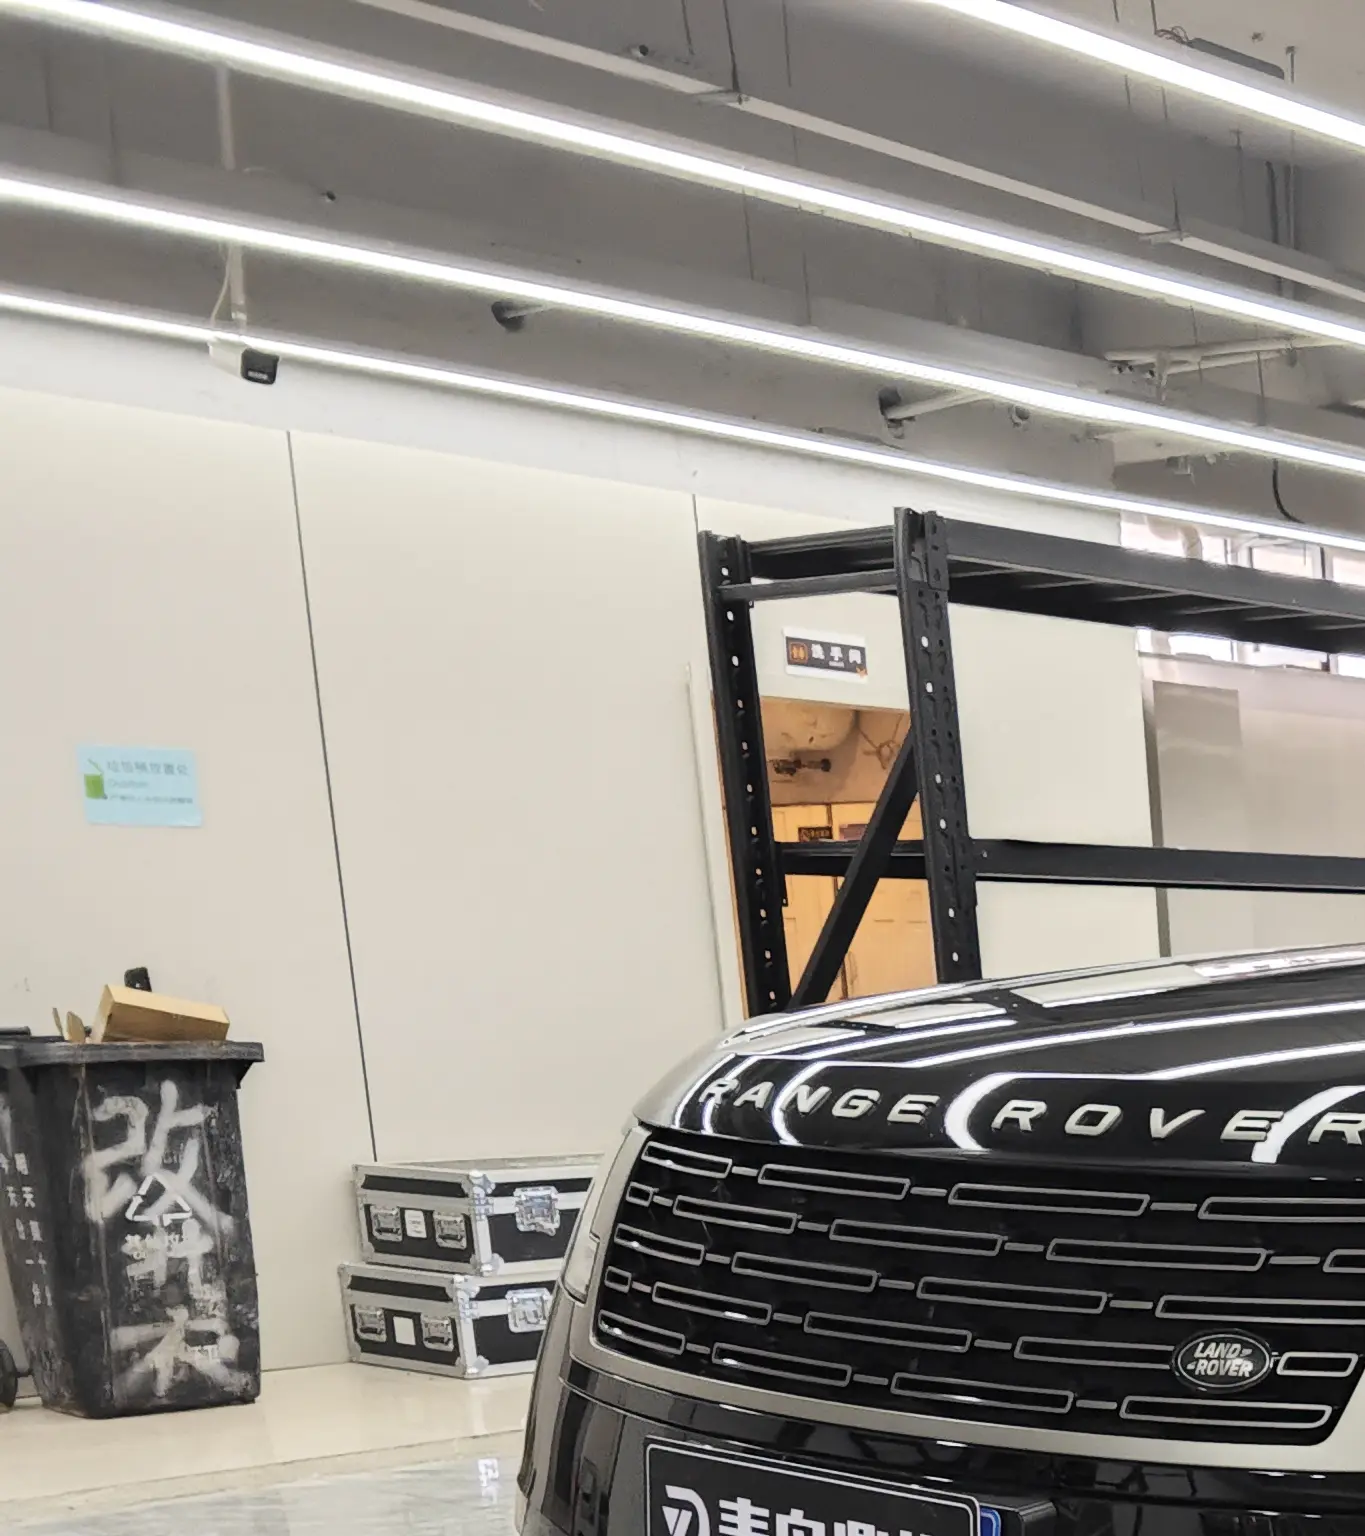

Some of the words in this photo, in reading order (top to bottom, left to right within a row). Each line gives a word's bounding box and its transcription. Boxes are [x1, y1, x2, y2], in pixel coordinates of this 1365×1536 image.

[699, 1078, 941, 1125] RANGE
[1193, 1341, 1242, 1359] LAND
[1194, 1358, 1254, 1378] ROVER
